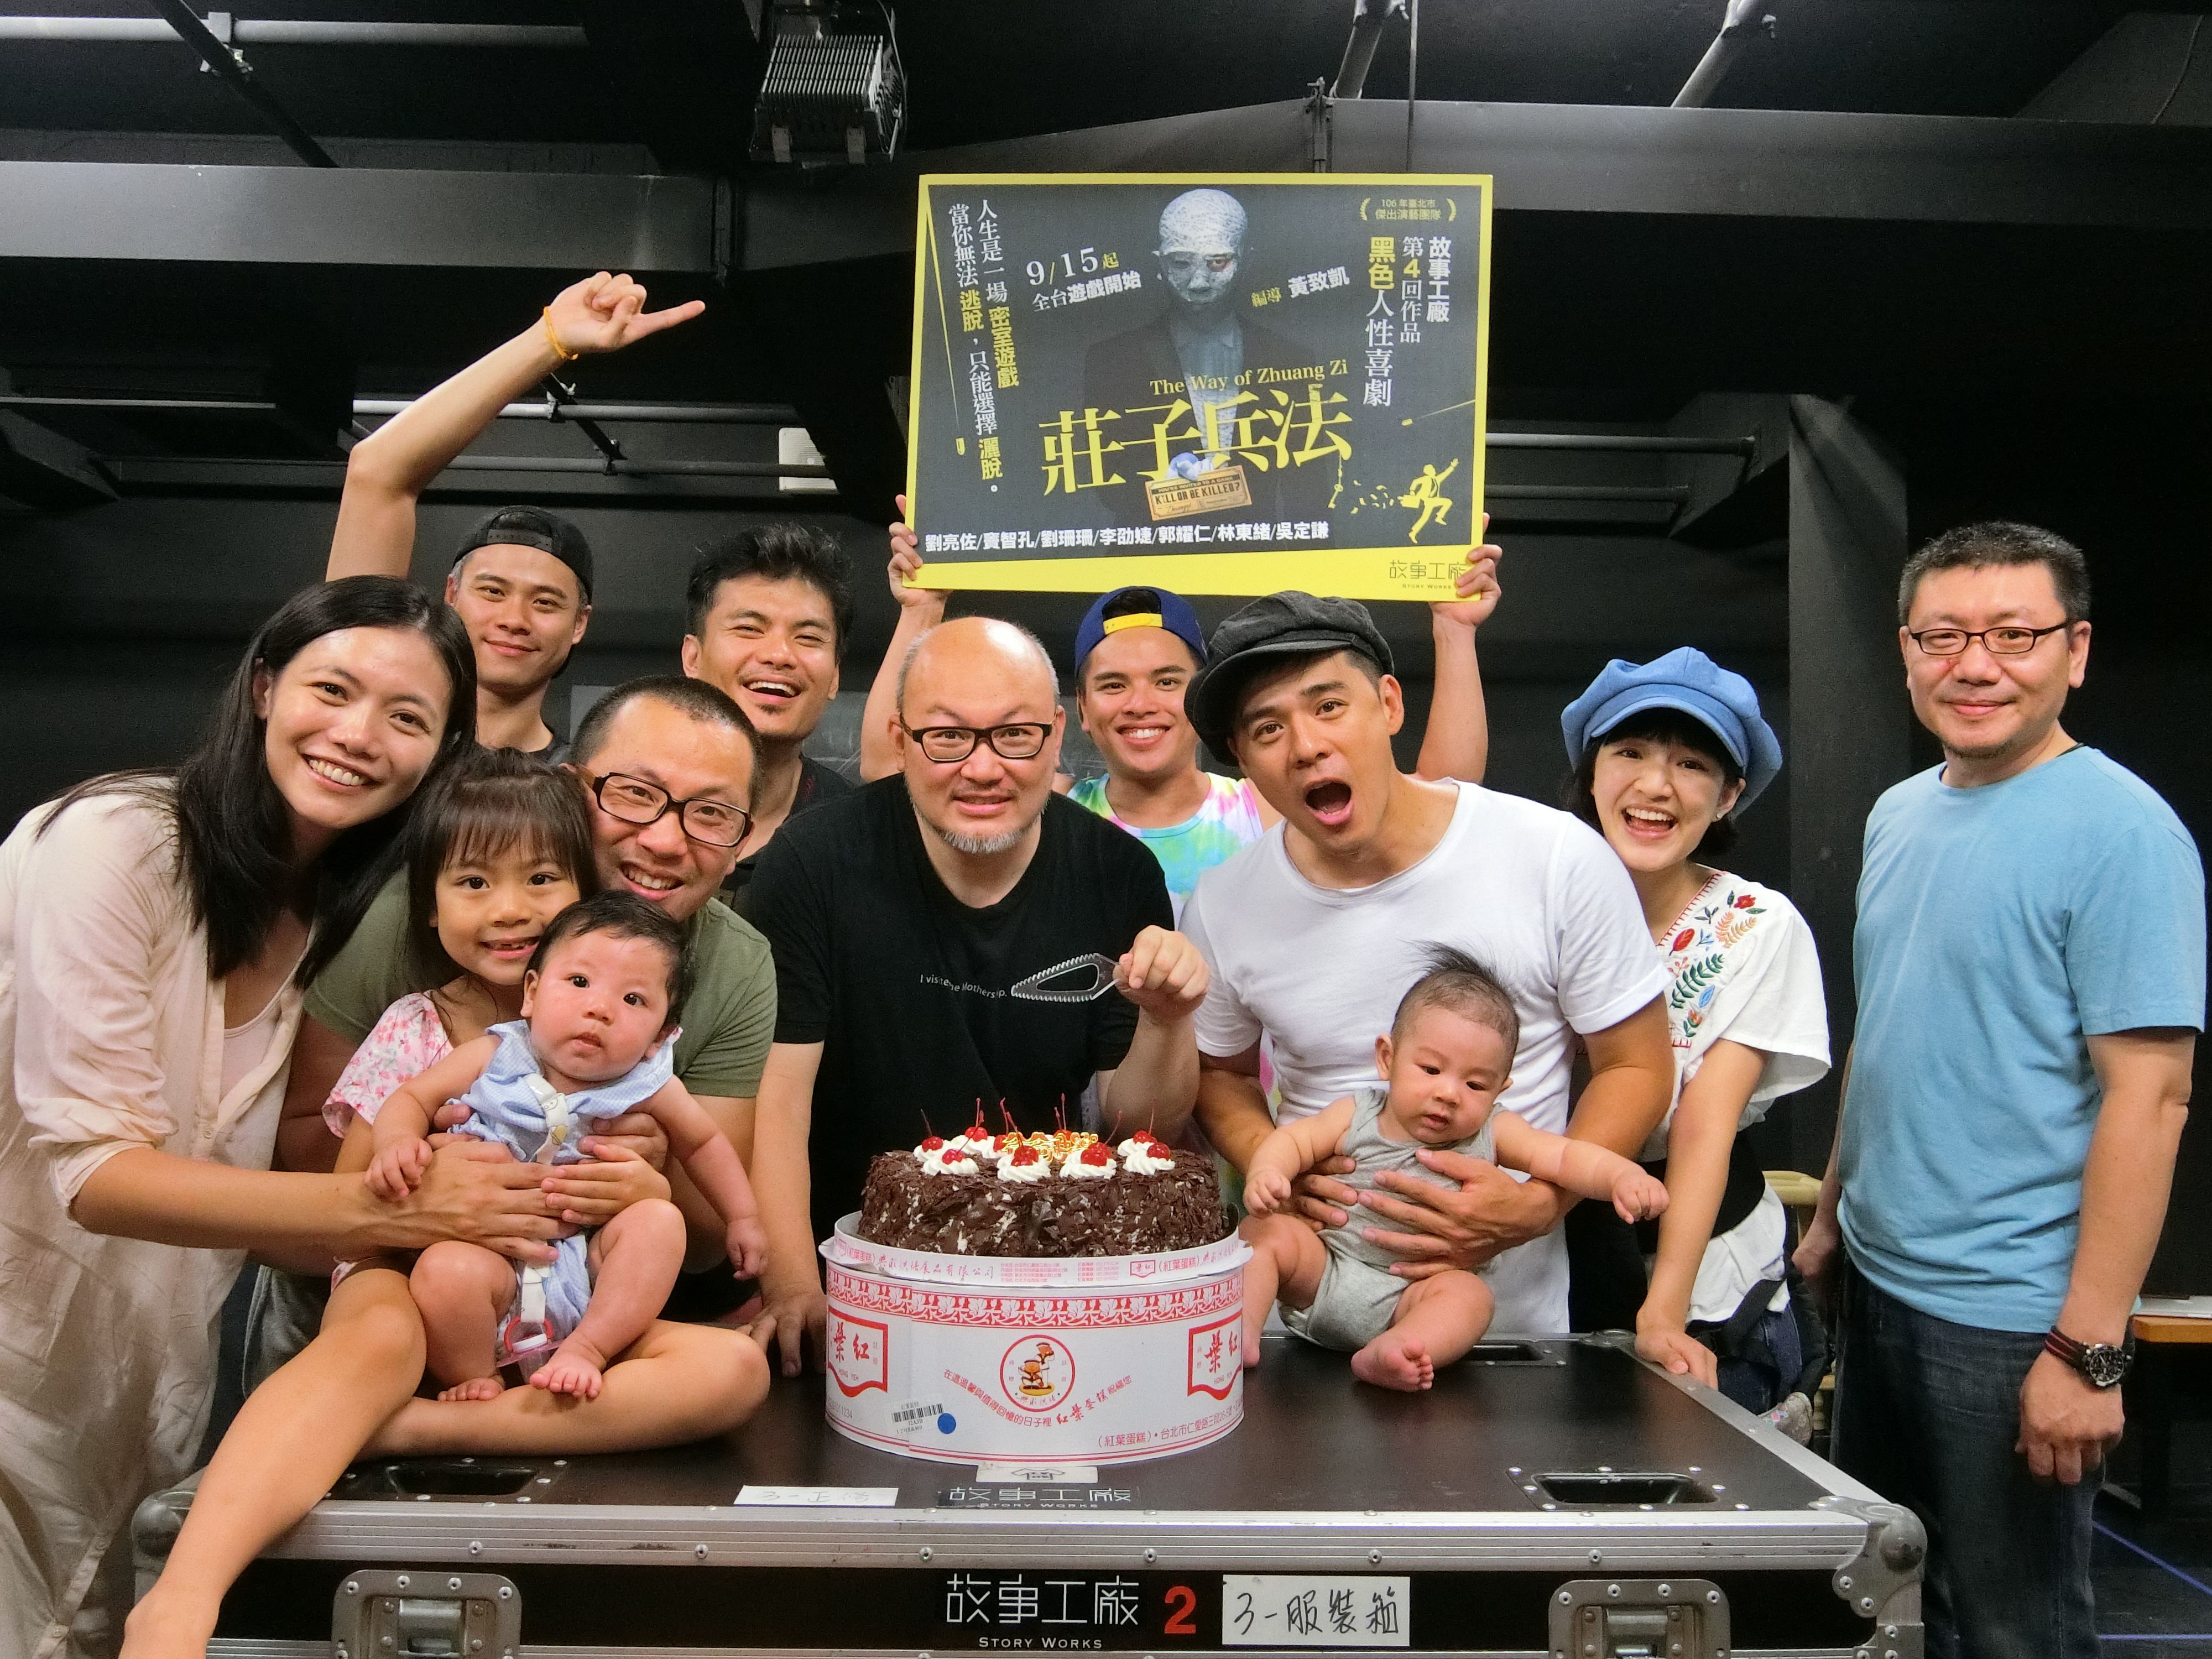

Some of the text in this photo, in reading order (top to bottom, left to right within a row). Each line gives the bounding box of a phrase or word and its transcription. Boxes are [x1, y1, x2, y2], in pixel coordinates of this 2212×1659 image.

[1031, 270, 1142, 312] 全台遊戲開始
[1288, 265, 1350, 299] 黃致凱
[1400, 236, 1425, 343] 第4回作品
[1426, 236, 1452, 322] 故事工廠
[1363, 237, 1396, 406] 黑色人性喜劇
[1150, 358, 1348, 395] The Way of Zhuang Zi
[1039, 383, 1353, 496] 莊子兵法
[1155, 482, 1240, 505] KILL OR BE KILLED?
[920, 974, 924, 983] I
[949, 1486, 1131, 1503] 故事工廠
[946, 1573, 1197, 1635] 故事工廠 2
[978, 1636, 1103, 1650] STORY WORKS
